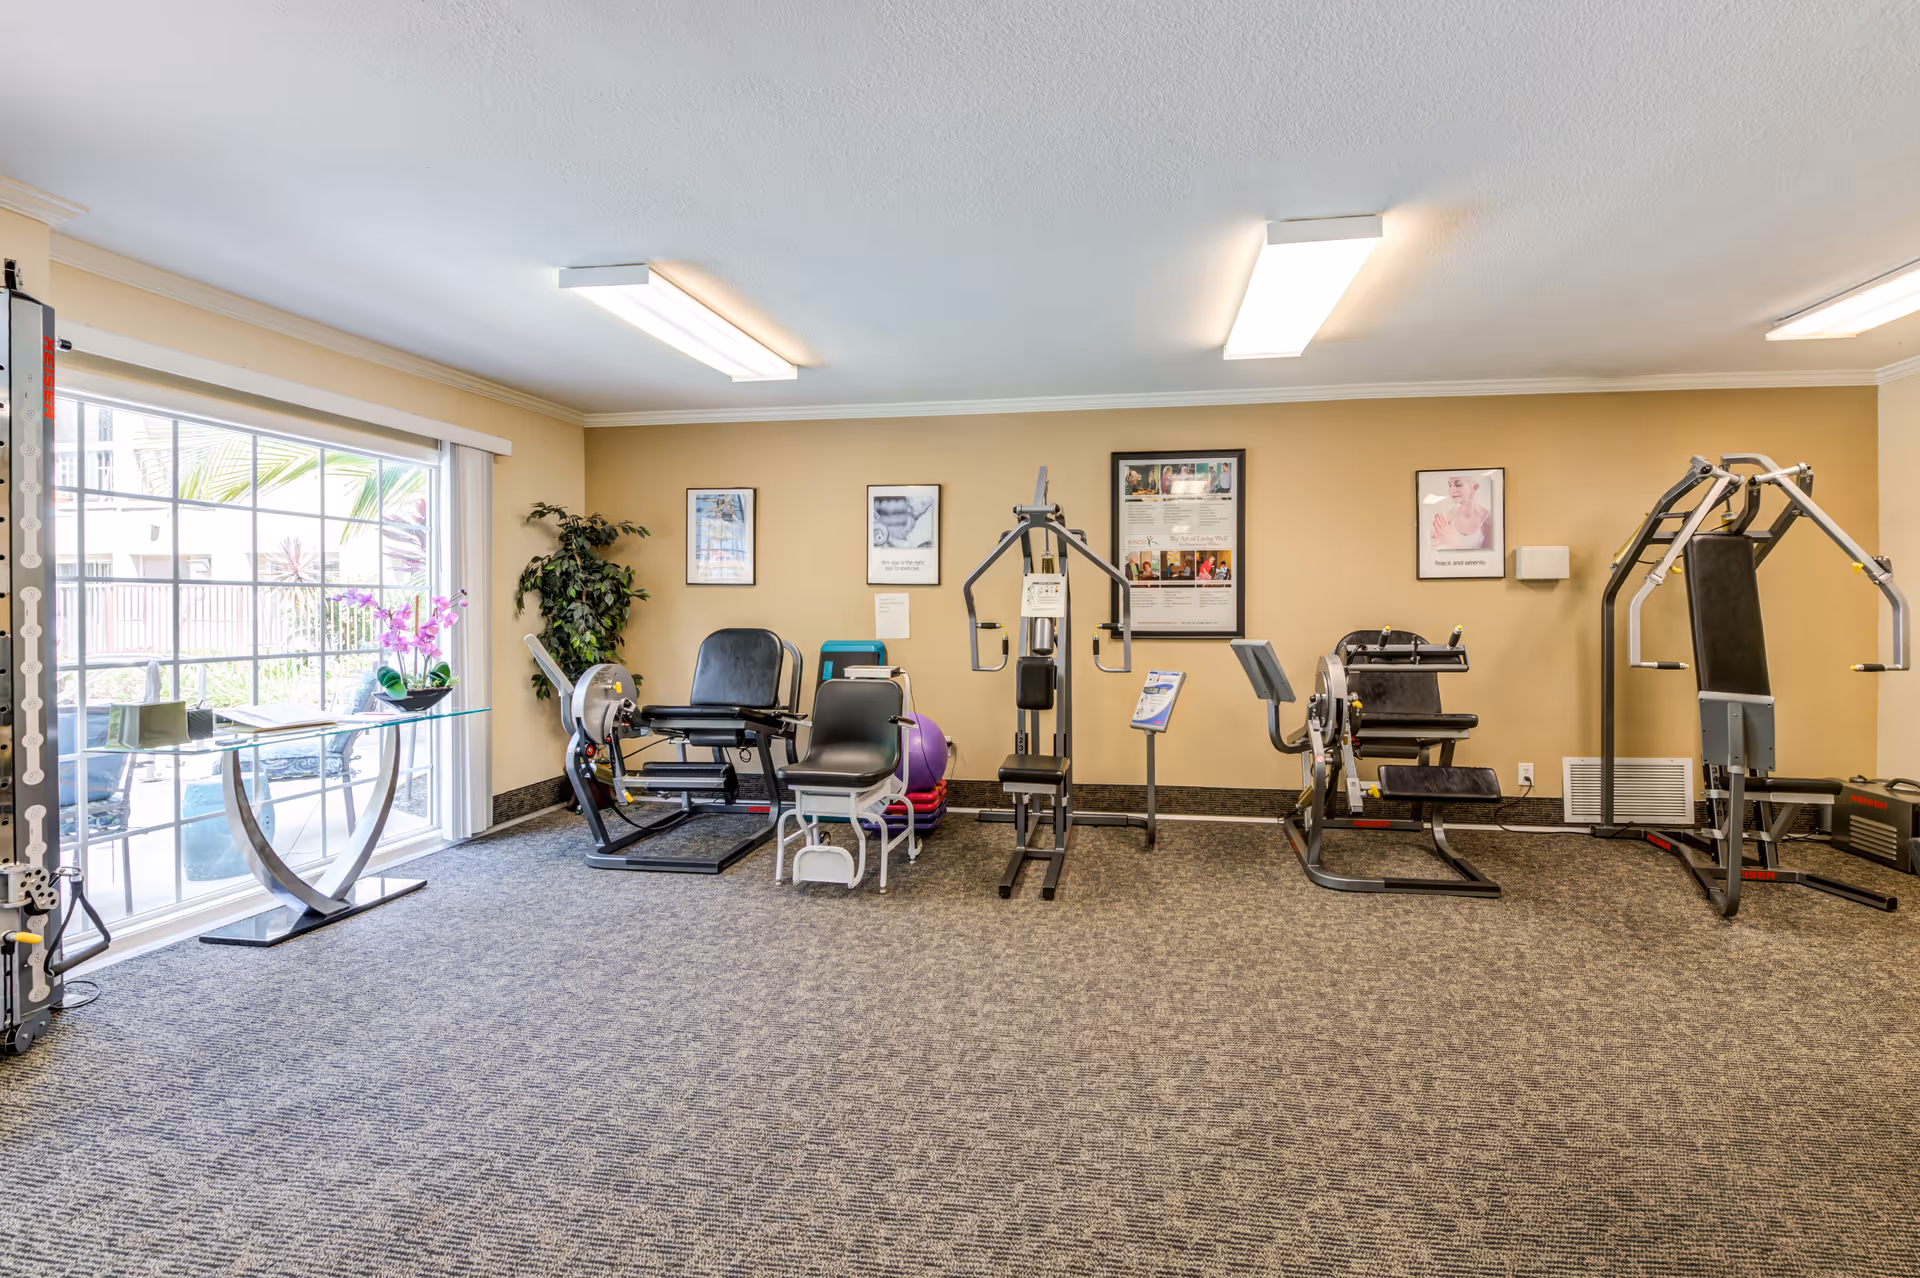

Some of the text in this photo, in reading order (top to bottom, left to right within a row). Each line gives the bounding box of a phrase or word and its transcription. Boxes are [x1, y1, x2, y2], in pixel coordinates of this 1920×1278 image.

[43, 335, 55, 421] KEISER
[25, 444, 35, 456] 3
[26, 624, 36, 637] 8
[1850, 794, 1889, 811] KEISER
[1352, 820, 1391, 828] KEISER
[1646, 833, 1672, 851] KEISER
[1741, 870, 1776, 880] ISER
